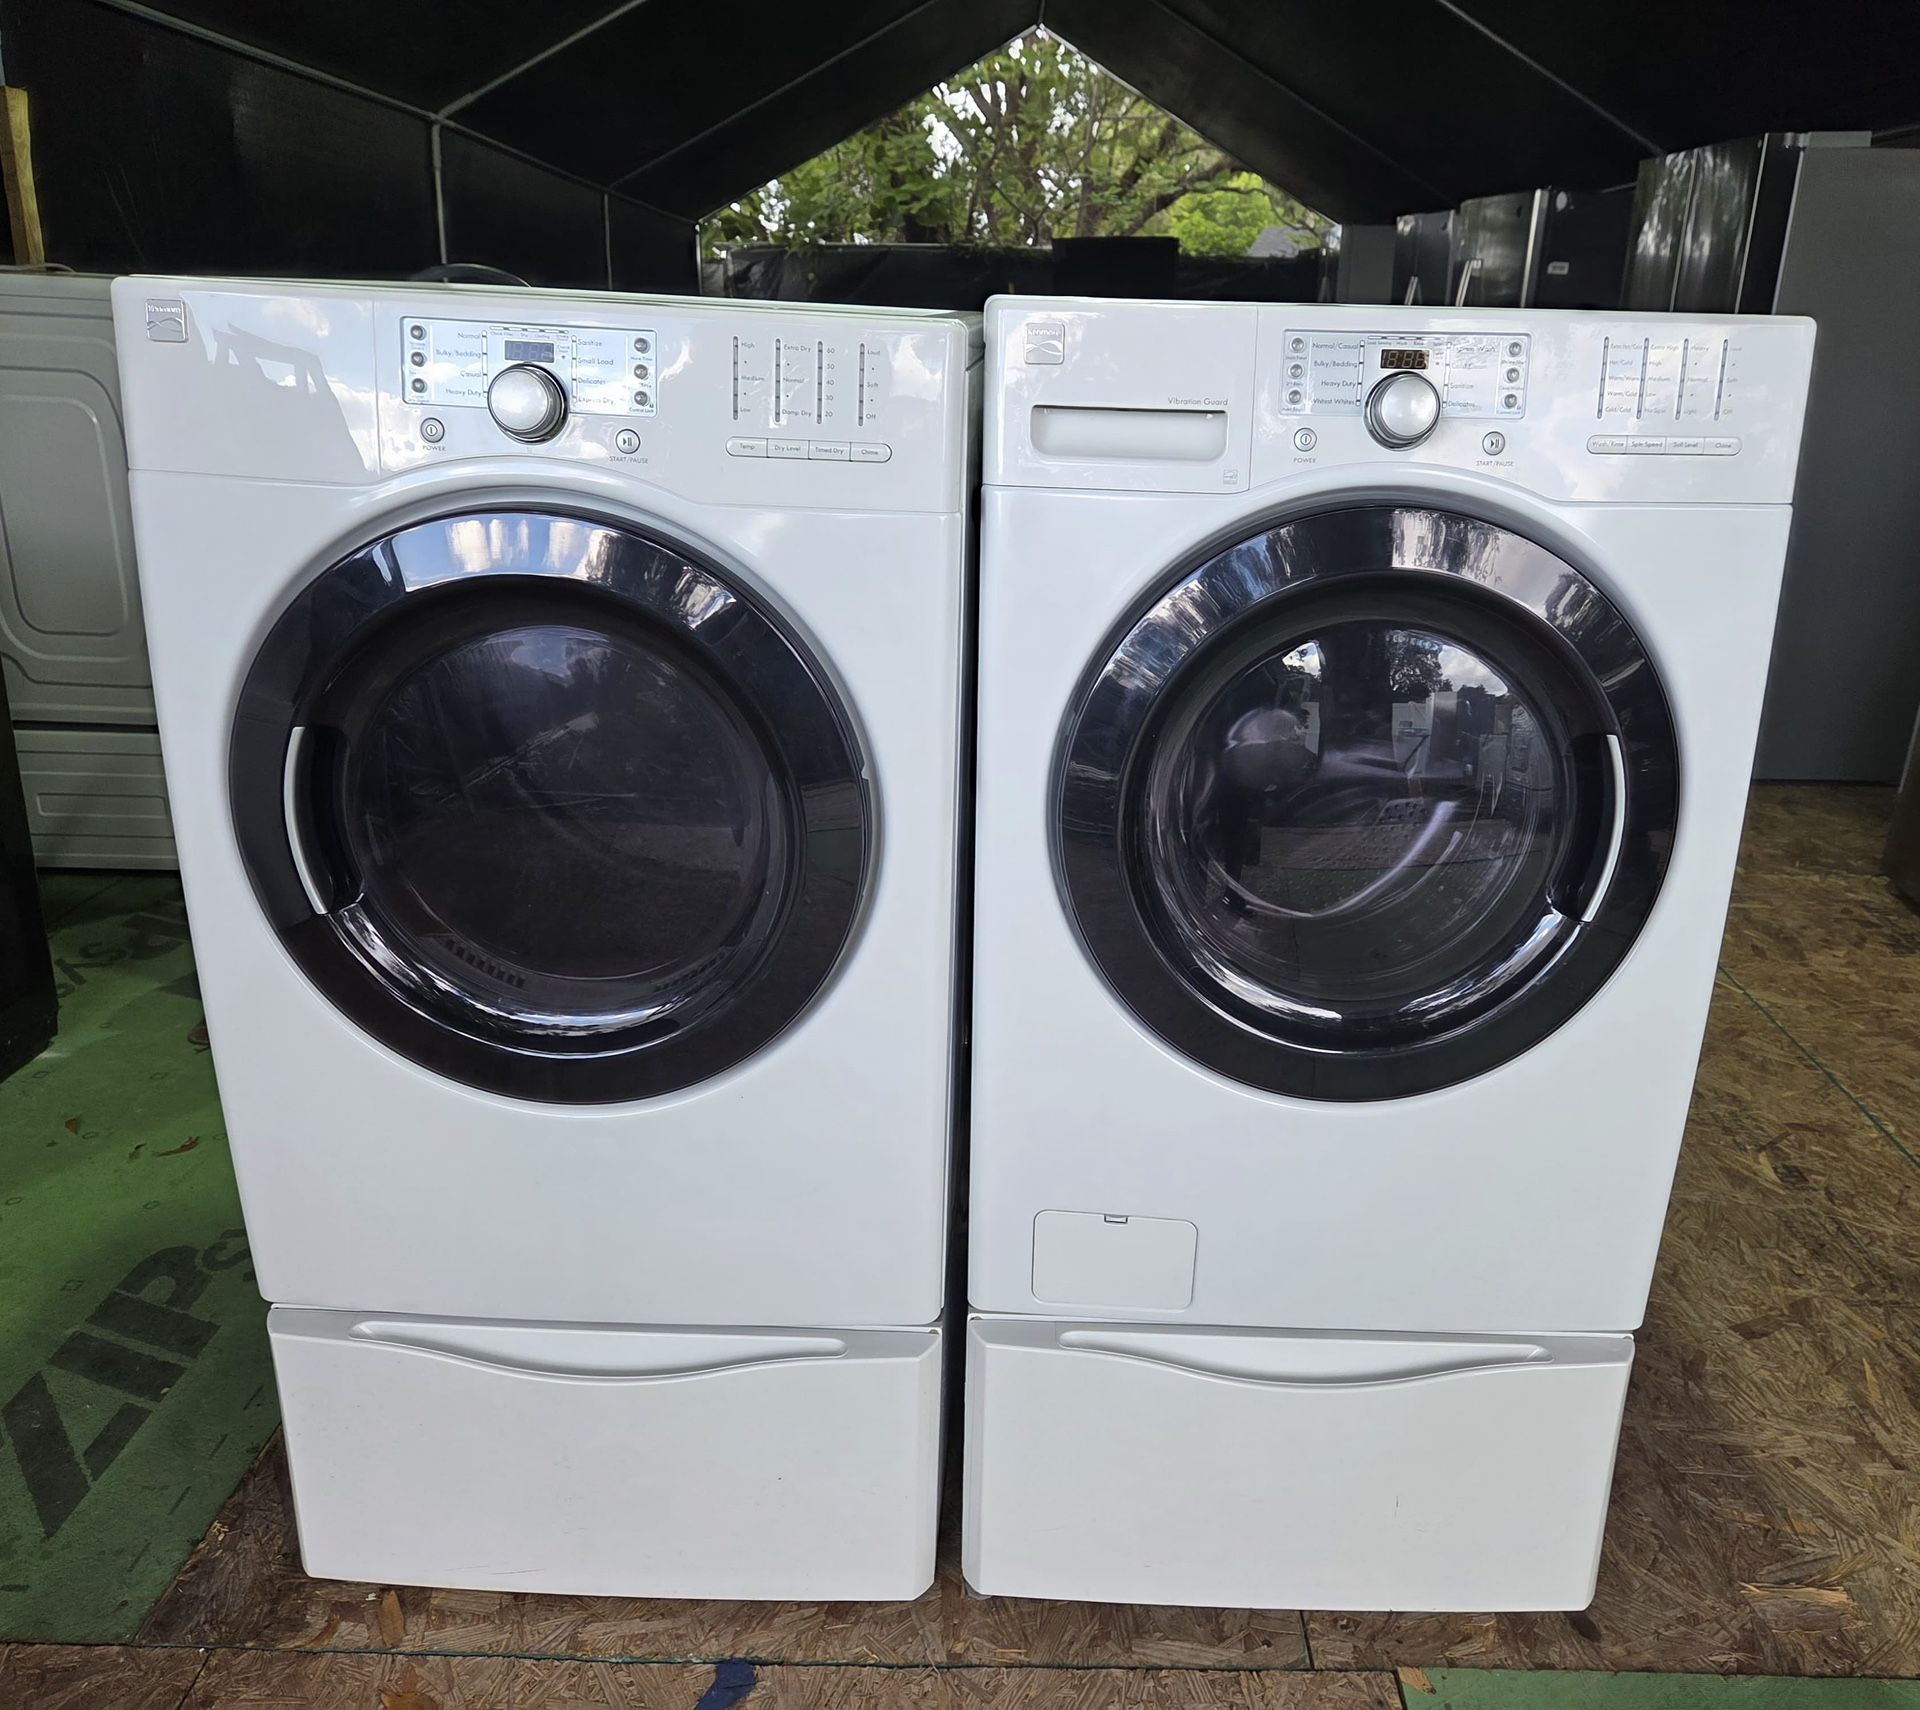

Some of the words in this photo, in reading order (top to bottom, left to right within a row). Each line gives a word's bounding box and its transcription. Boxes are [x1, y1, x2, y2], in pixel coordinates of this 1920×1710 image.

[741, 342, 755, 350] High
[800, 345, 812, 353] Dry
[1314, 360, 1358, 368] Bulky/Bedding
[1320, 380, 1341, 388] Heavy
[1342, 380, 1356, 389] Duty
[467, 389, 482, 398] Duty
[1168, 397, 1202, 405] Vibration
[1203, 398, 1228, 406] Guard
[740, 443, 755, 451] Temp
[774, 445, 785, 453] Dry
[1645, 441, 1663, 449] Speed
[830, 447, 844, 455] Dry
[608, 455, 649, 464] START/PAUSE
[1293, 456, 1316, 464] POWER
